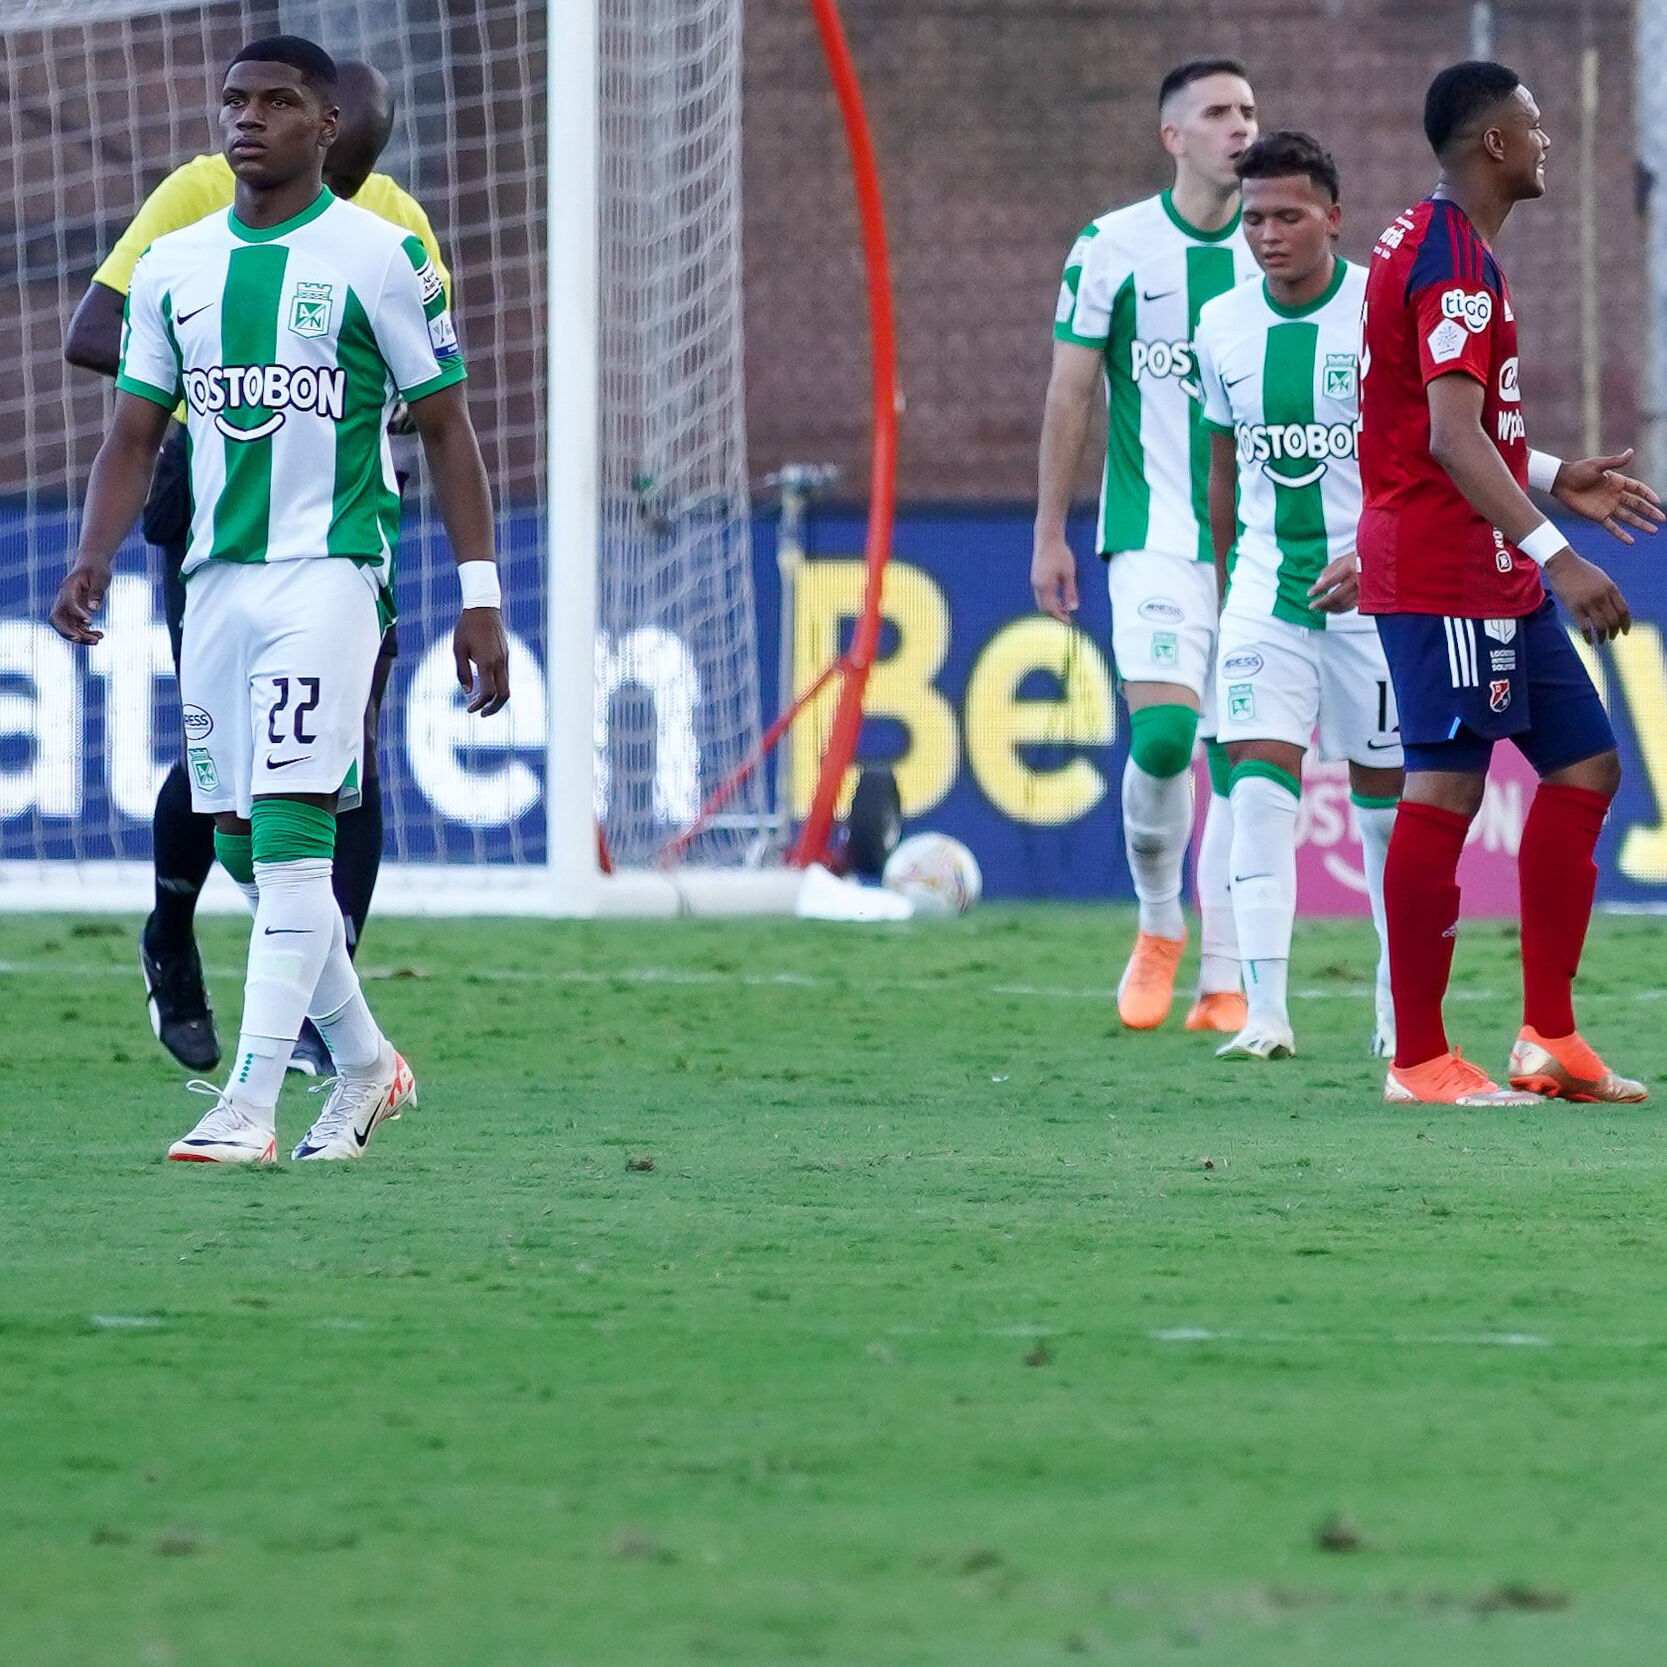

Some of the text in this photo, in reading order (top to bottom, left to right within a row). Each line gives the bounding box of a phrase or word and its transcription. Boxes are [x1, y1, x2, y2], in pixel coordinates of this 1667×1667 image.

[1237, 423, 1363, 461] OSTOBO
[268, 677, 320, 744] 22
[405, 623, 702, 825] en
